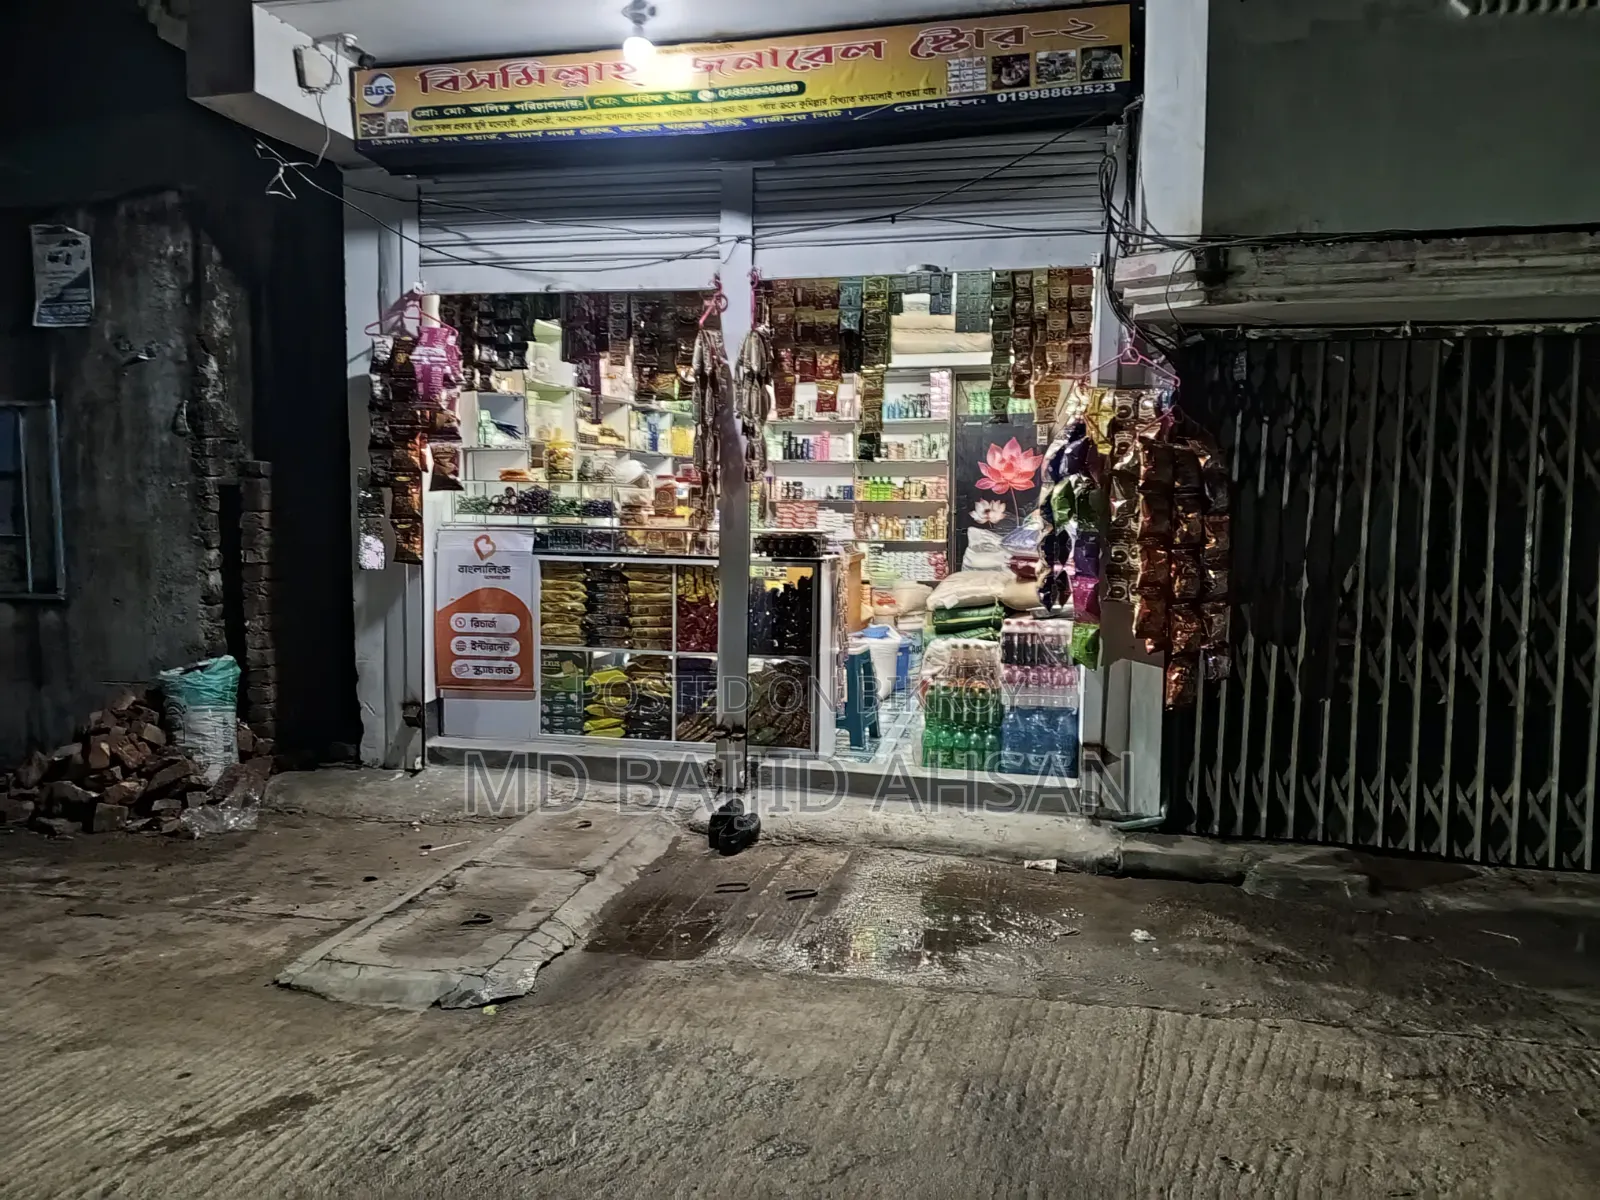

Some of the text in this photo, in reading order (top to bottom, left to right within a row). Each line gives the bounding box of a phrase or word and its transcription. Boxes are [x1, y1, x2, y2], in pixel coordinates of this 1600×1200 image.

[686, 40, 887, 77] জনারেল
[908, 17, 1110, 60] স্টোর-২
[363, 84, 397, 96] BGS
[858, 90, 893, 103] রসমালাই
[895, 88, 920, 99] পাওয়া
[996, 83, 1116, 103] 01998862523
[442, 106, 467, 117] মোঃ
[457, 562, 511, 575] বাংলালিংক
[470, 616, 498, 629] রিচার্জ
[470, 640, 511, 652] ইন্টারনেট
[495, 663, 515, 675] কার্ড
